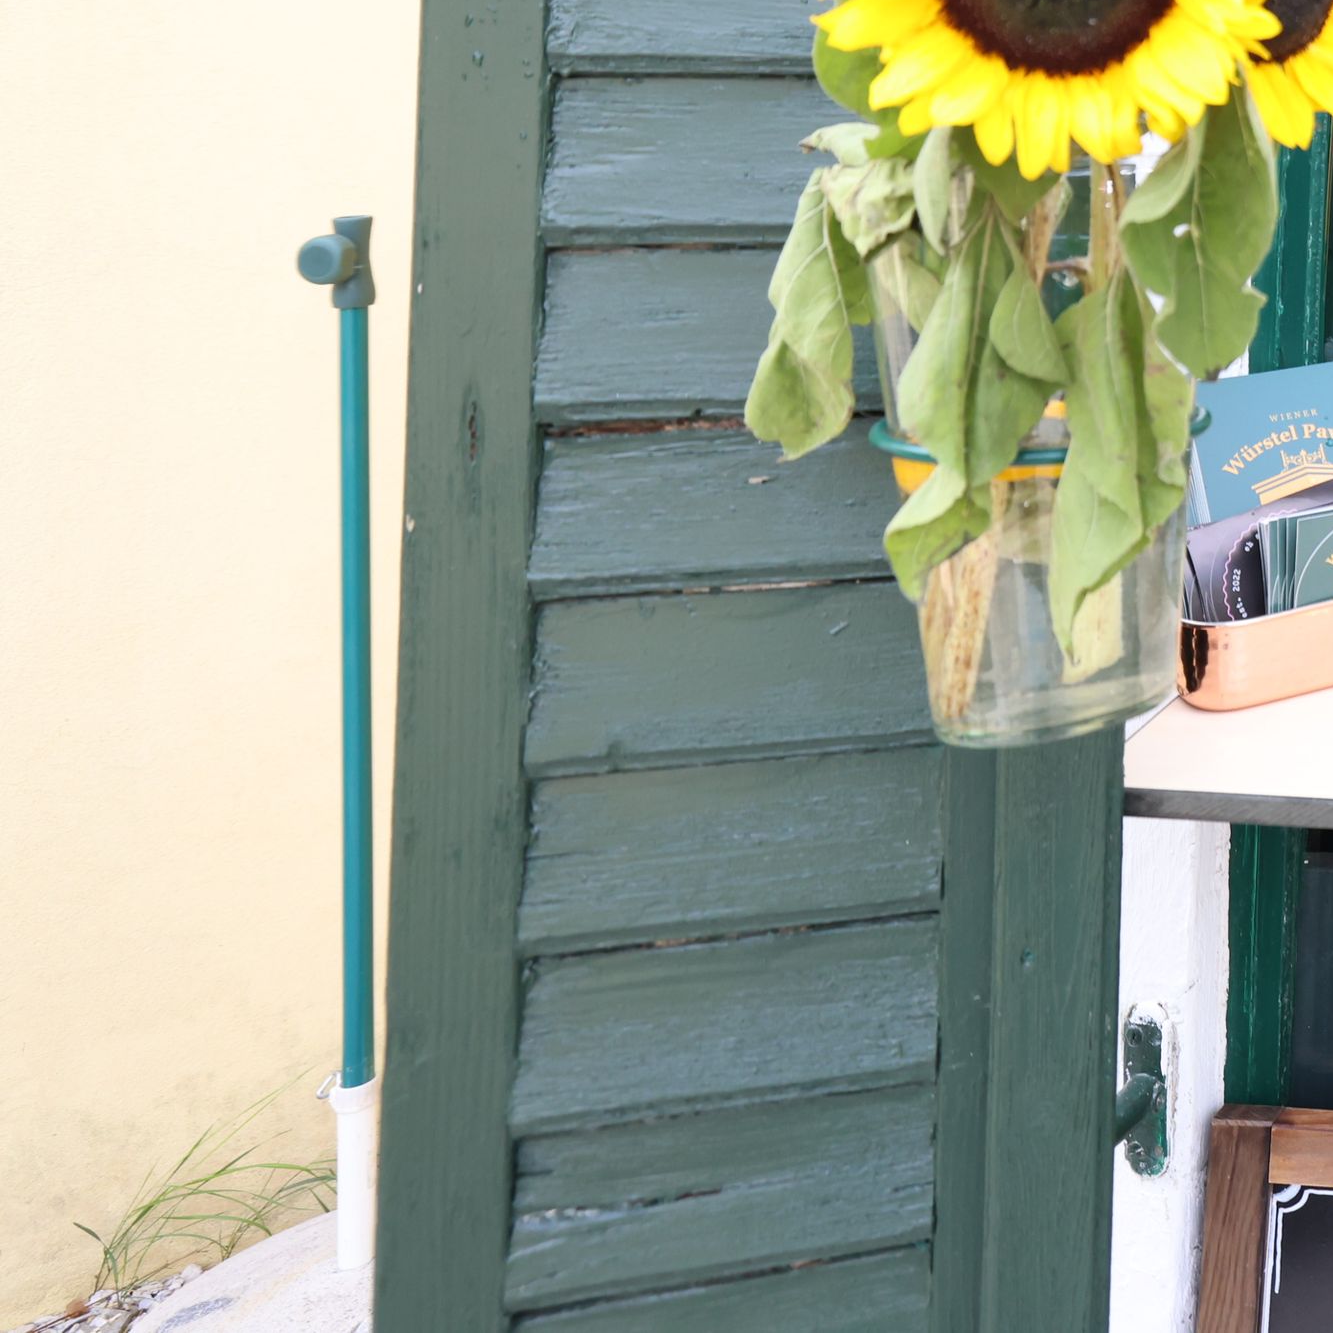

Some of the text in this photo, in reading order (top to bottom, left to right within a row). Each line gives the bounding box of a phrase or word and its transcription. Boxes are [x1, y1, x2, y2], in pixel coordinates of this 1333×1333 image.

[1269, 409, 1319, 423] WIENER
[1222, 425, 1298, 475] Würstel
[1232, 568, 1241, 592] 2022
